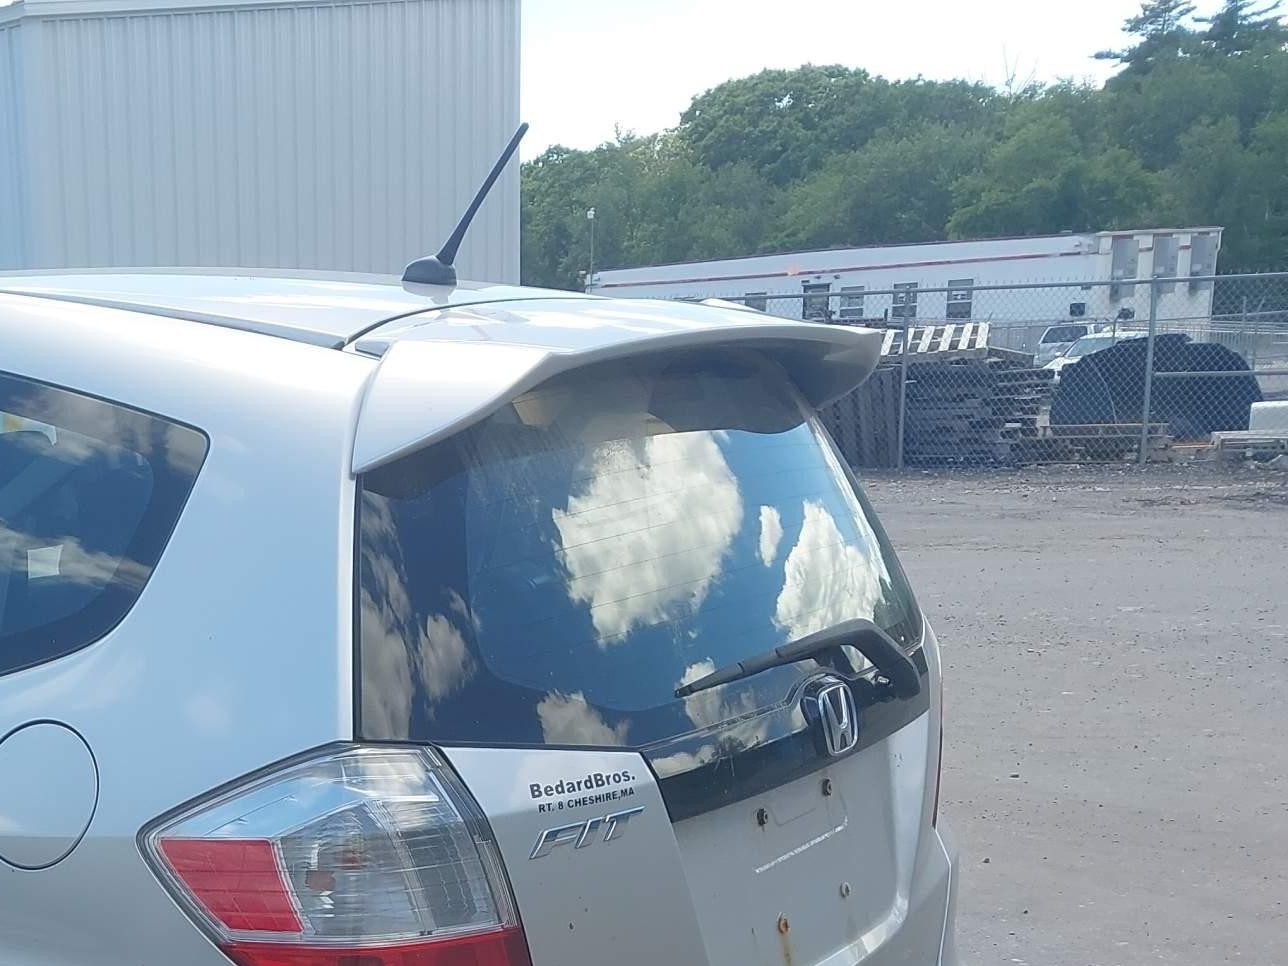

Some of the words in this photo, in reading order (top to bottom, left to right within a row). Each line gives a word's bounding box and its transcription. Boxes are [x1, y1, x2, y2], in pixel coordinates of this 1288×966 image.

[529, 769, 636, 799] BedardBros.
[538, 802, 555, 814] RT.
[558, 801, 564, 810] 8
[528, 805, 646, 860] FIT
